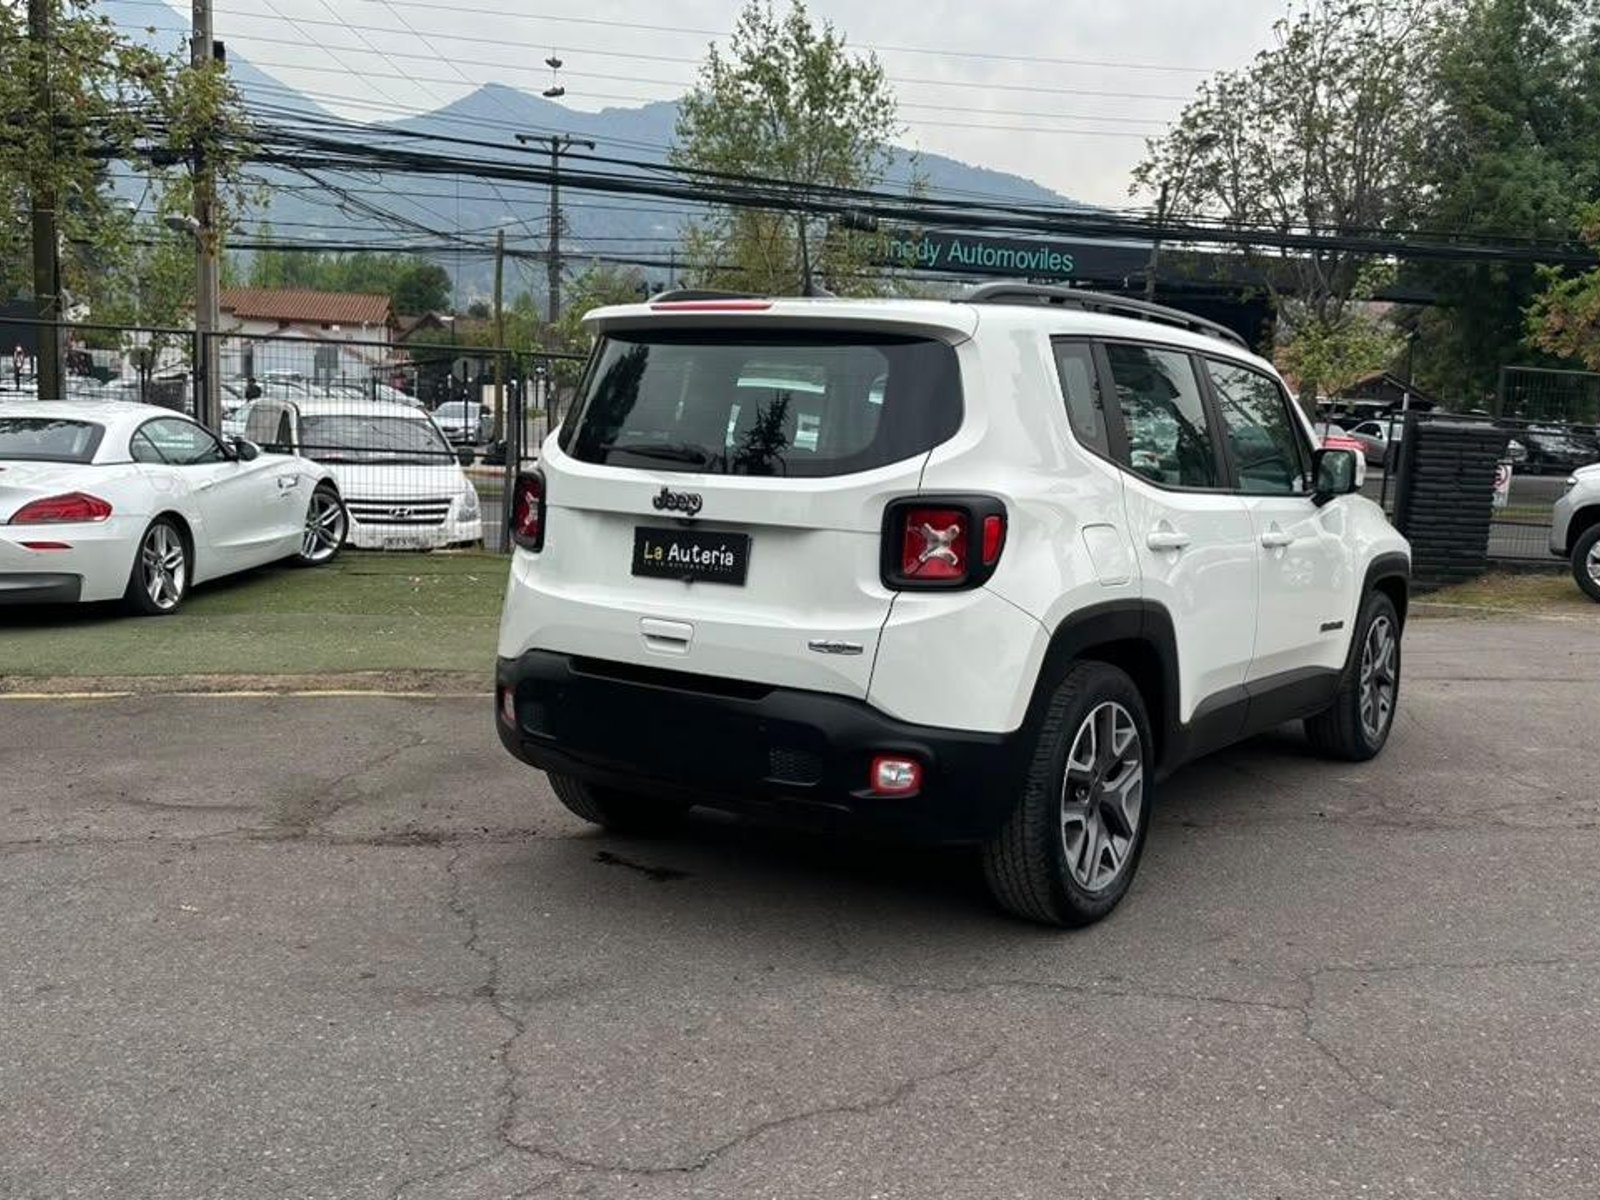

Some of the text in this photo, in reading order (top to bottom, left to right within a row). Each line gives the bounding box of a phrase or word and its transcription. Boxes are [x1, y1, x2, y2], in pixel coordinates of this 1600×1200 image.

[947, 239, 1074, 272] Automoviles
[652, 486, 703, 516] Jeep
[644, 541, 664, 560] La
[667, 543, 734, 566] Autería
